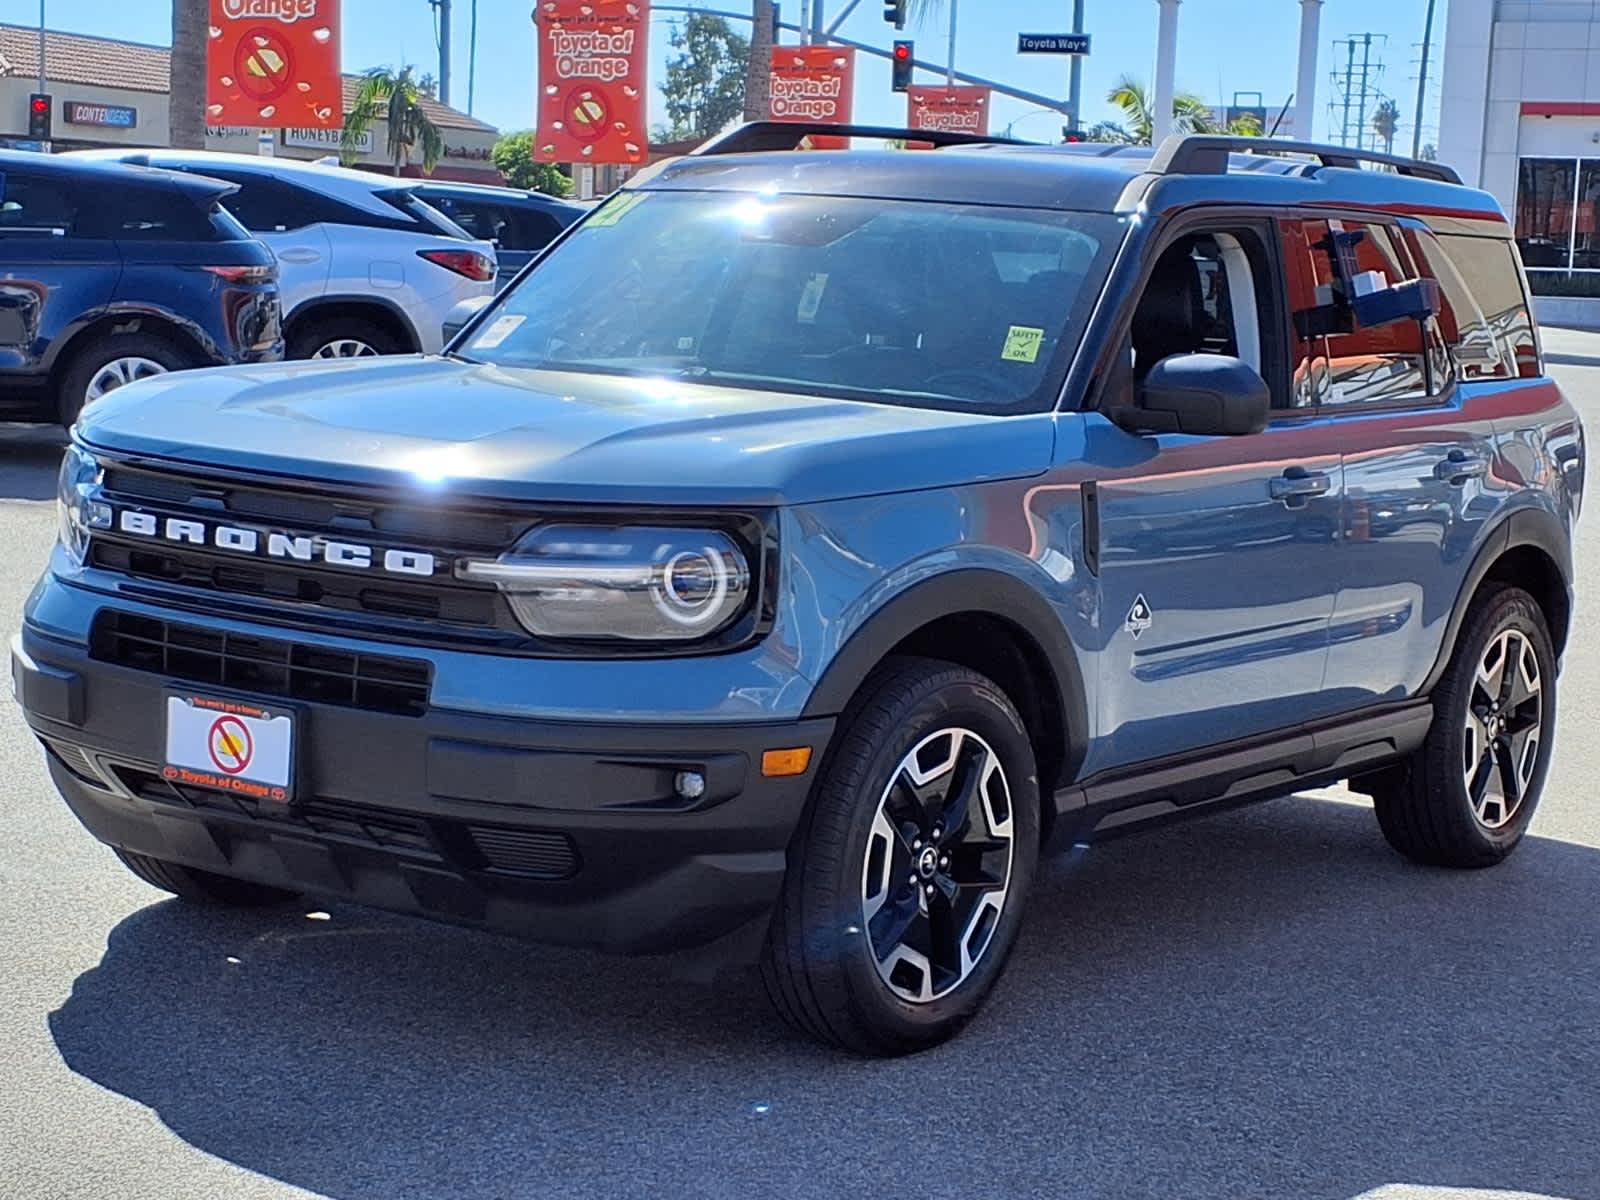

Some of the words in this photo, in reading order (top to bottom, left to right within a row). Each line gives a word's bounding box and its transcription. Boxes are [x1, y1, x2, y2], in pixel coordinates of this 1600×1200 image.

[222, 0, 316, 23] Orange
[550, 29, 609, 56] Toyota
[611, 29, 635, 54] of
[1022, 38, 1056, 50] Toyota
[1058, 39, 1080, 51] Way
[557, 56, 629, 81] Orange
[769, 76, 820, 98] Toyota
[821, 76, 841, 97] of
[75, 105, 131, 124] CONTENDERS
[772, 97, 836, 119] Orange
[917, 110, 963, 129] Toyota
[963, 111, 979, 128] of
[1012, 329, 1039, 339] SAFETY
[1013, 350, 1027, 358] OK
[121, 510, 434, 576] BRONCO
[181, 769, 217, 785] Toyota
[218, 777, 230, 788] of
[232, 780, 269, 796] Orange
